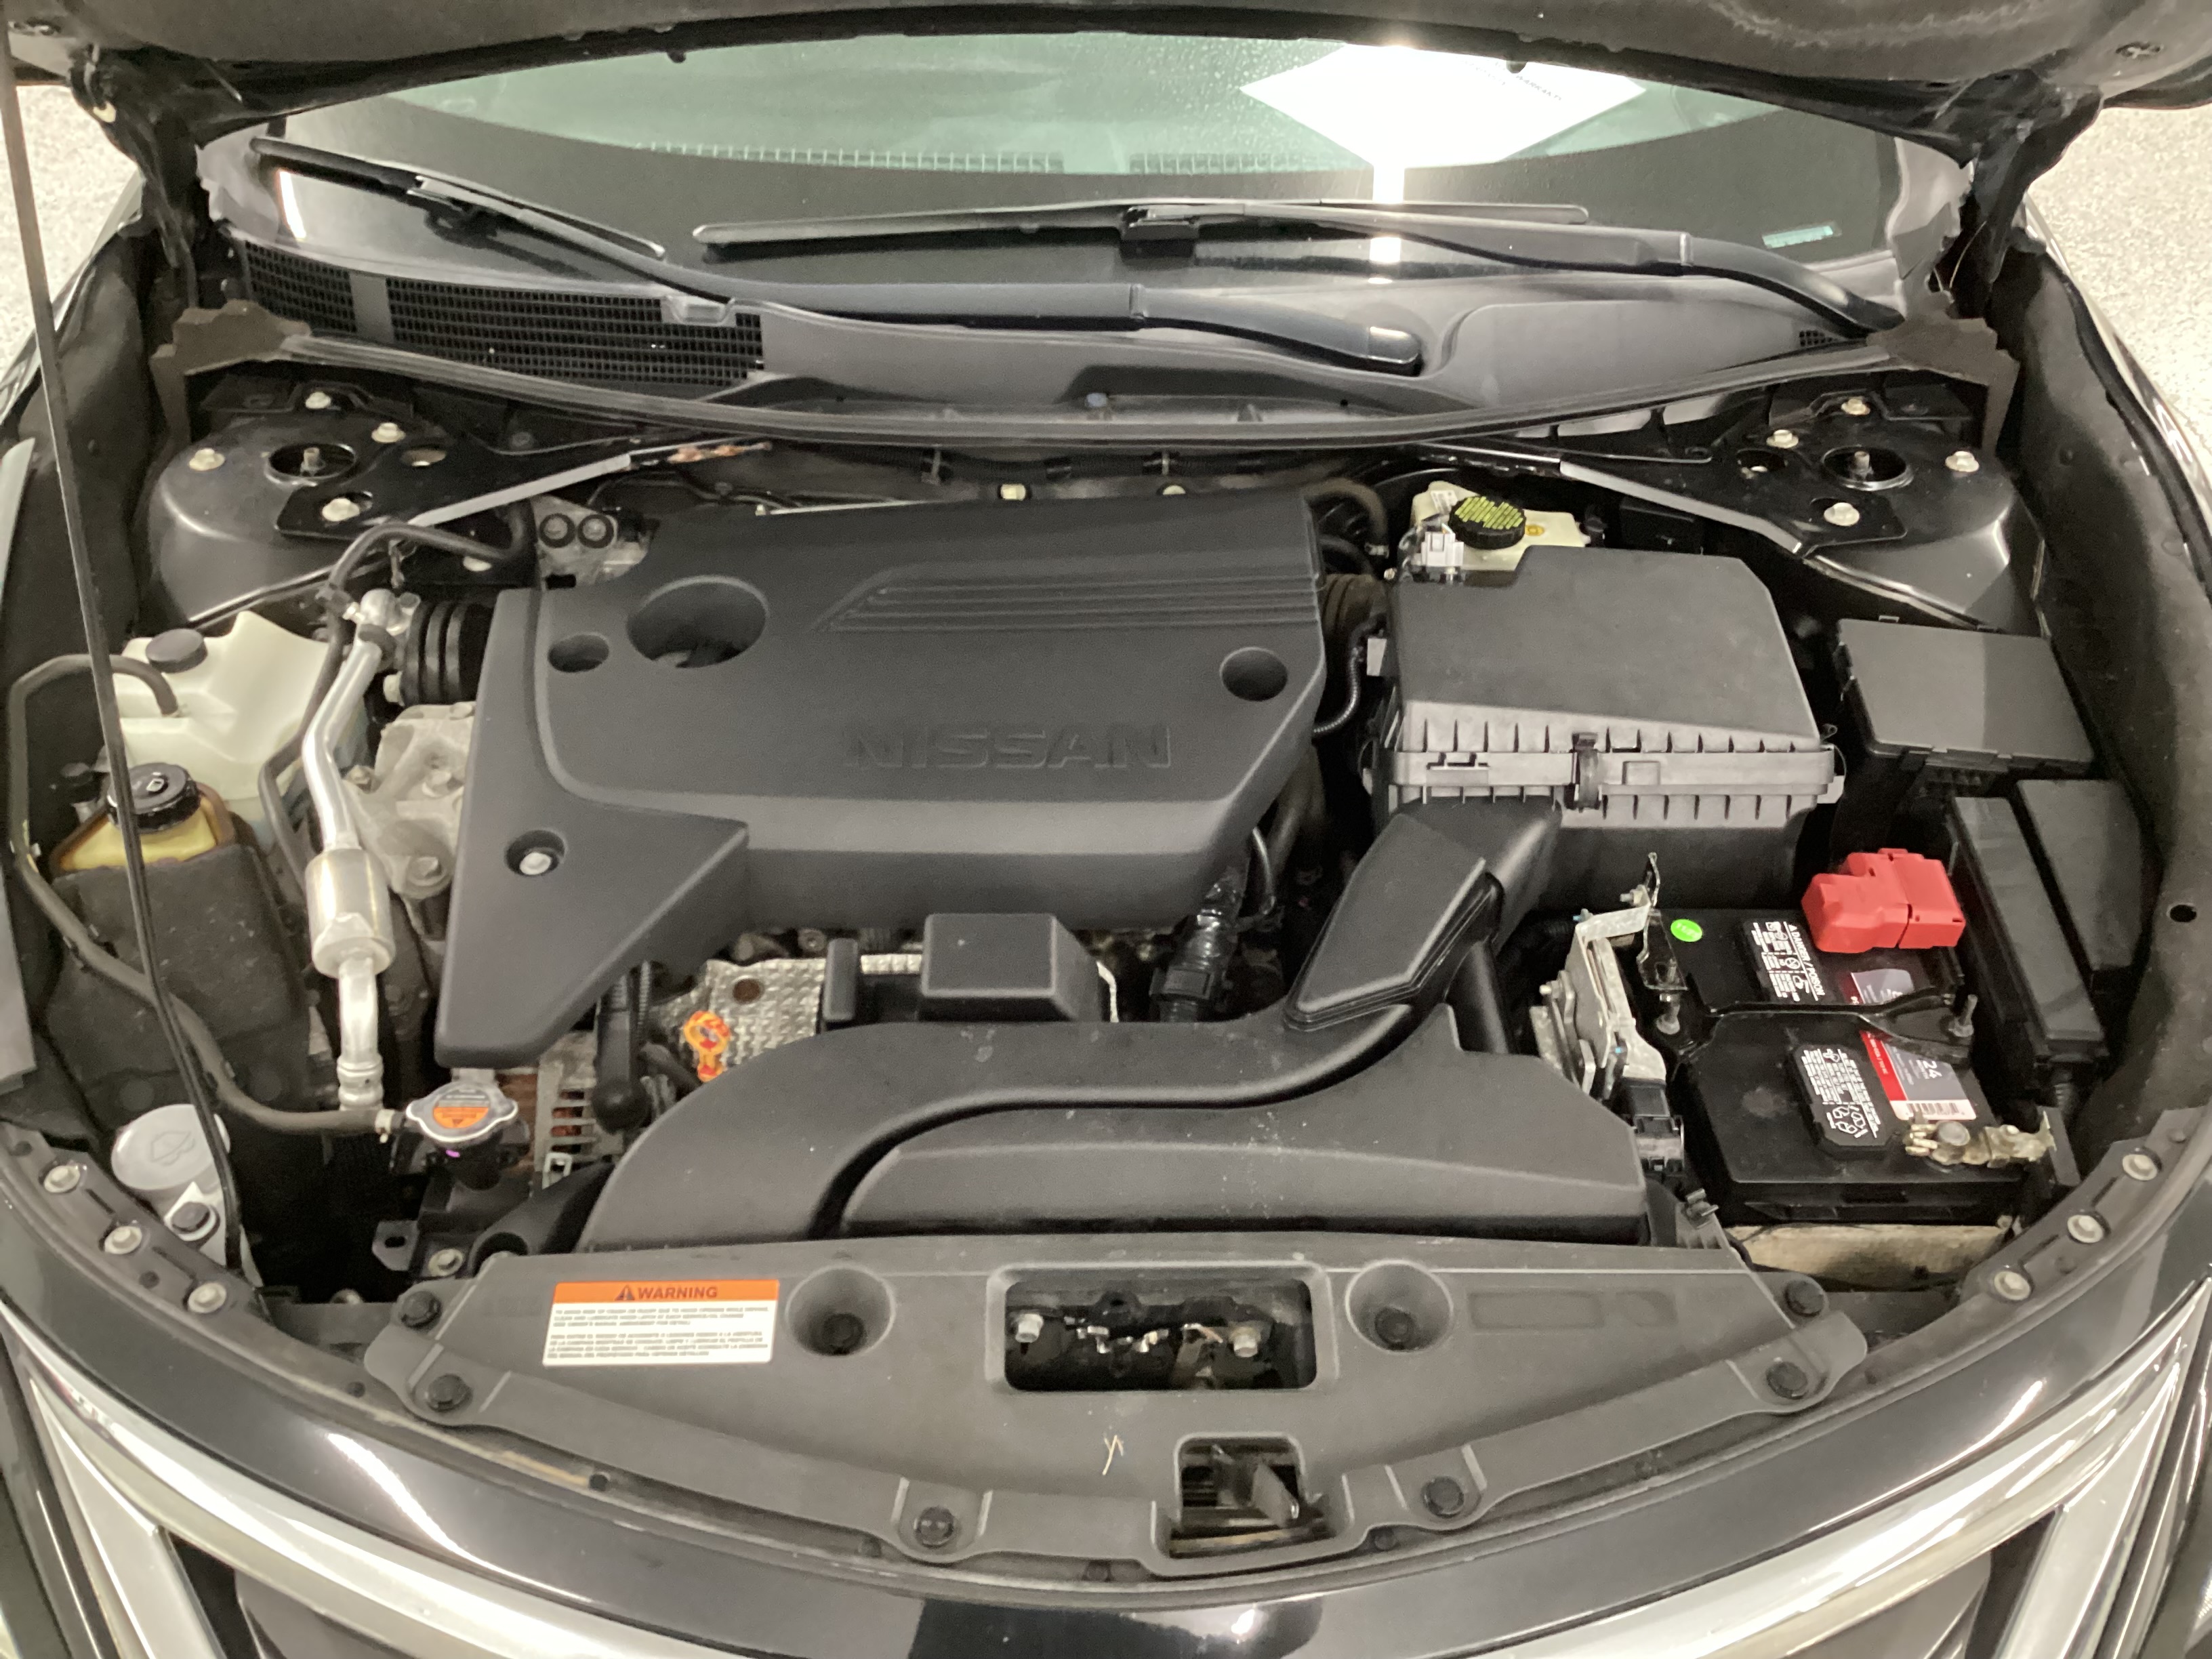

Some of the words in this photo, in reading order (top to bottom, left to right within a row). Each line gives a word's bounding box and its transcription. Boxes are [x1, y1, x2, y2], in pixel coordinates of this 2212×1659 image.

[842, 724, 1171, 769] NISSAN
[1791, 931, 1811, 961] DANGER
[1806, 967, 1826, 996] POISON
[1923, 1060, 1943, 1079] 24
[638, 1286, 718, 1300] WARNING
